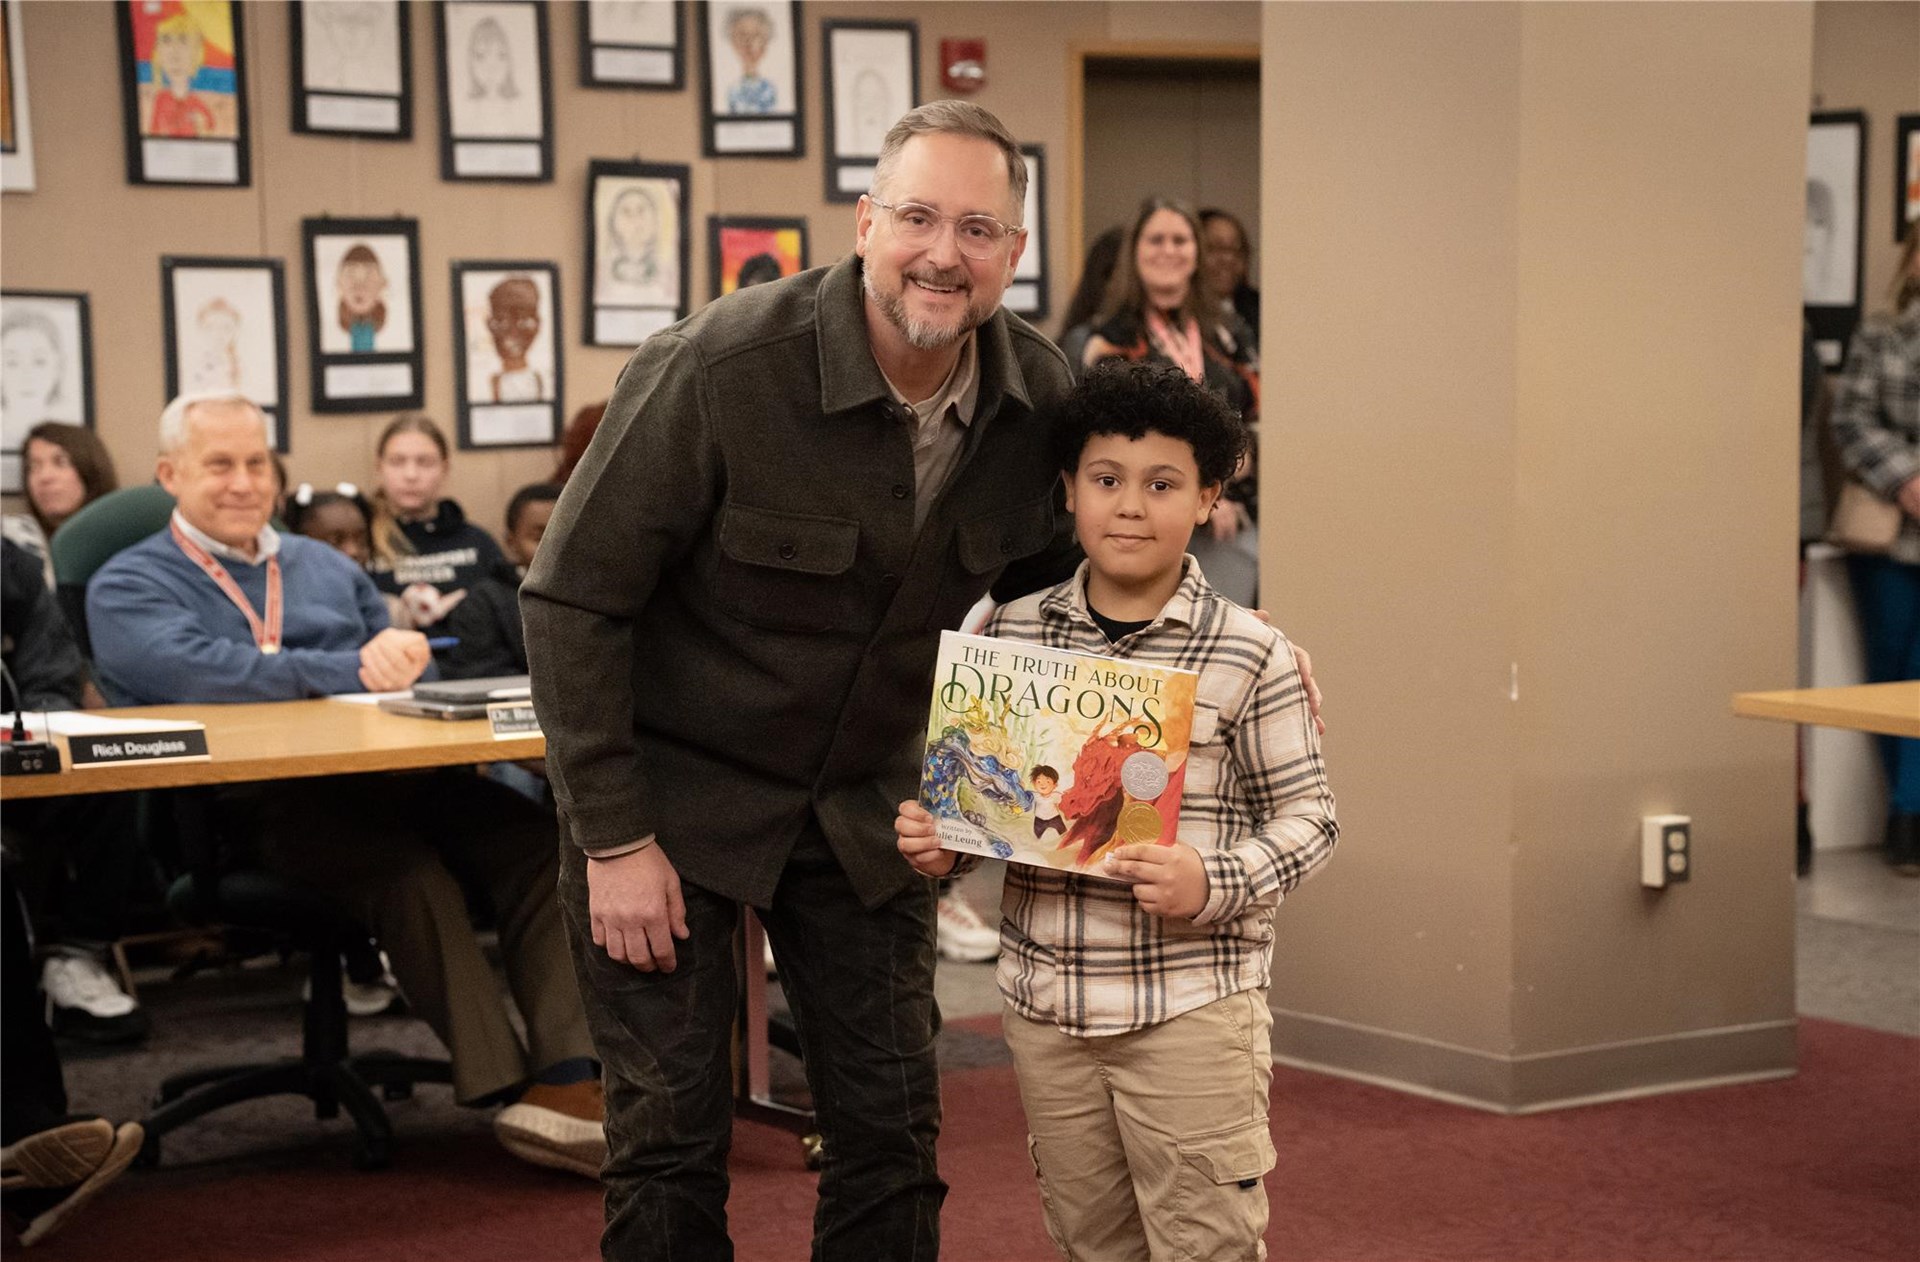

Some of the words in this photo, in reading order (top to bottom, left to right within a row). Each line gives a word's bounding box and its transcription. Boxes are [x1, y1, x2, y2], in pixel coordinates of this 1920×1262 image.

[963, 645, 1000, 668] THE
[1011, 654, 1077, 681] TRUTH
[1088, 669, 1163, 695] ABOUT
[940, 662, 1163, 748] DRAGONS
[92, 743, 123, 757] Rick
[124, 740, 186, 756] Douglass
[936, 831, 953, 841] ulie
[955, 834, 982, 848] Leung
[965, 827, 973, 835] by
